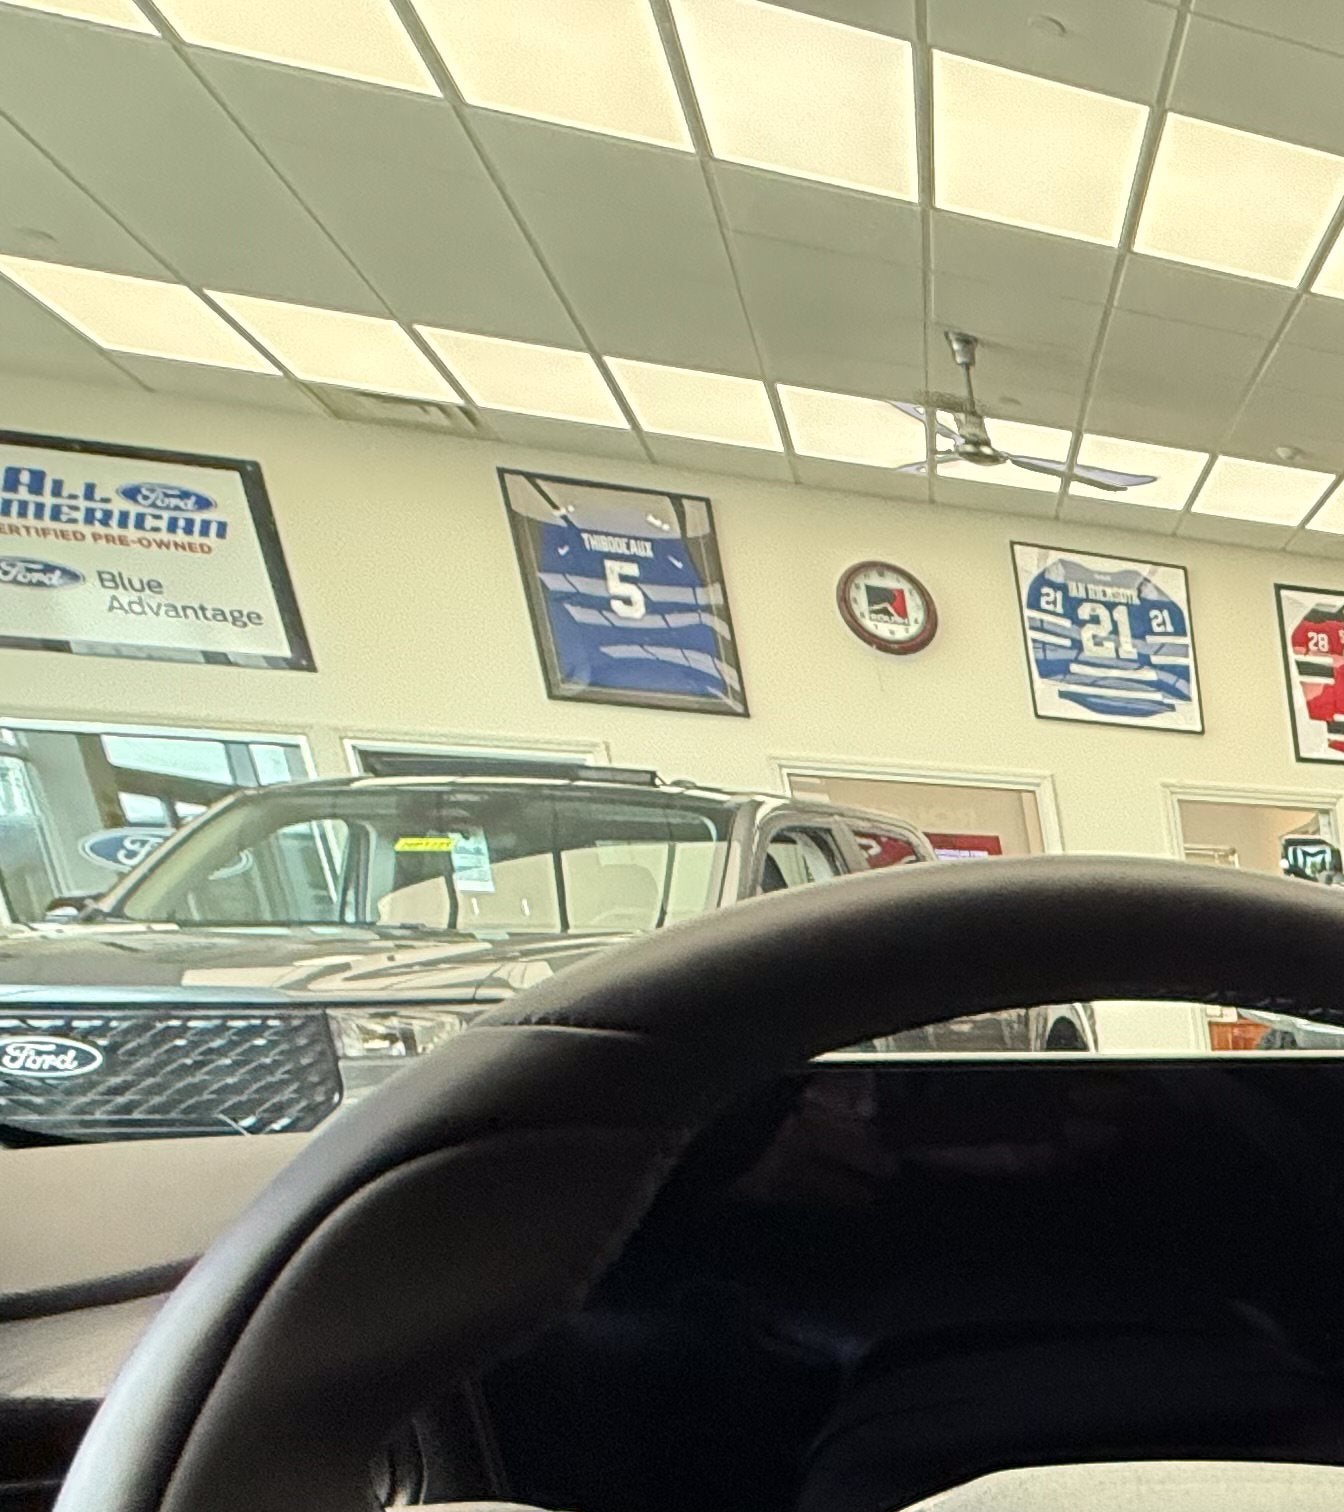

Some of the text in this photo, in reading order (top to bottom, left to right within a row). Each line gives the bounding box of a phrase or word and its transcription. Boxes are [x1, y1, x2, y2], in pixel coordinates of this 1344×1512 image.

[2, 466, 112, 503] ALL
[0, 497, 229, 540] MERICAN
[0, 523, 213, 555] ERTIFIED PRE-OWNED
[96, 570, 164, 595] Blue
[603, 559, 646, 620] 5
[107, 595, 264, 628] Advantage
[1040, 586, 1064, 614] 21
[1077, 601, 1138, 659] 21
[1148, 608, 1174, 633] 21
[1307, 631, 1329, 652] 28
[2, 1043, 78, 1070] Ford
